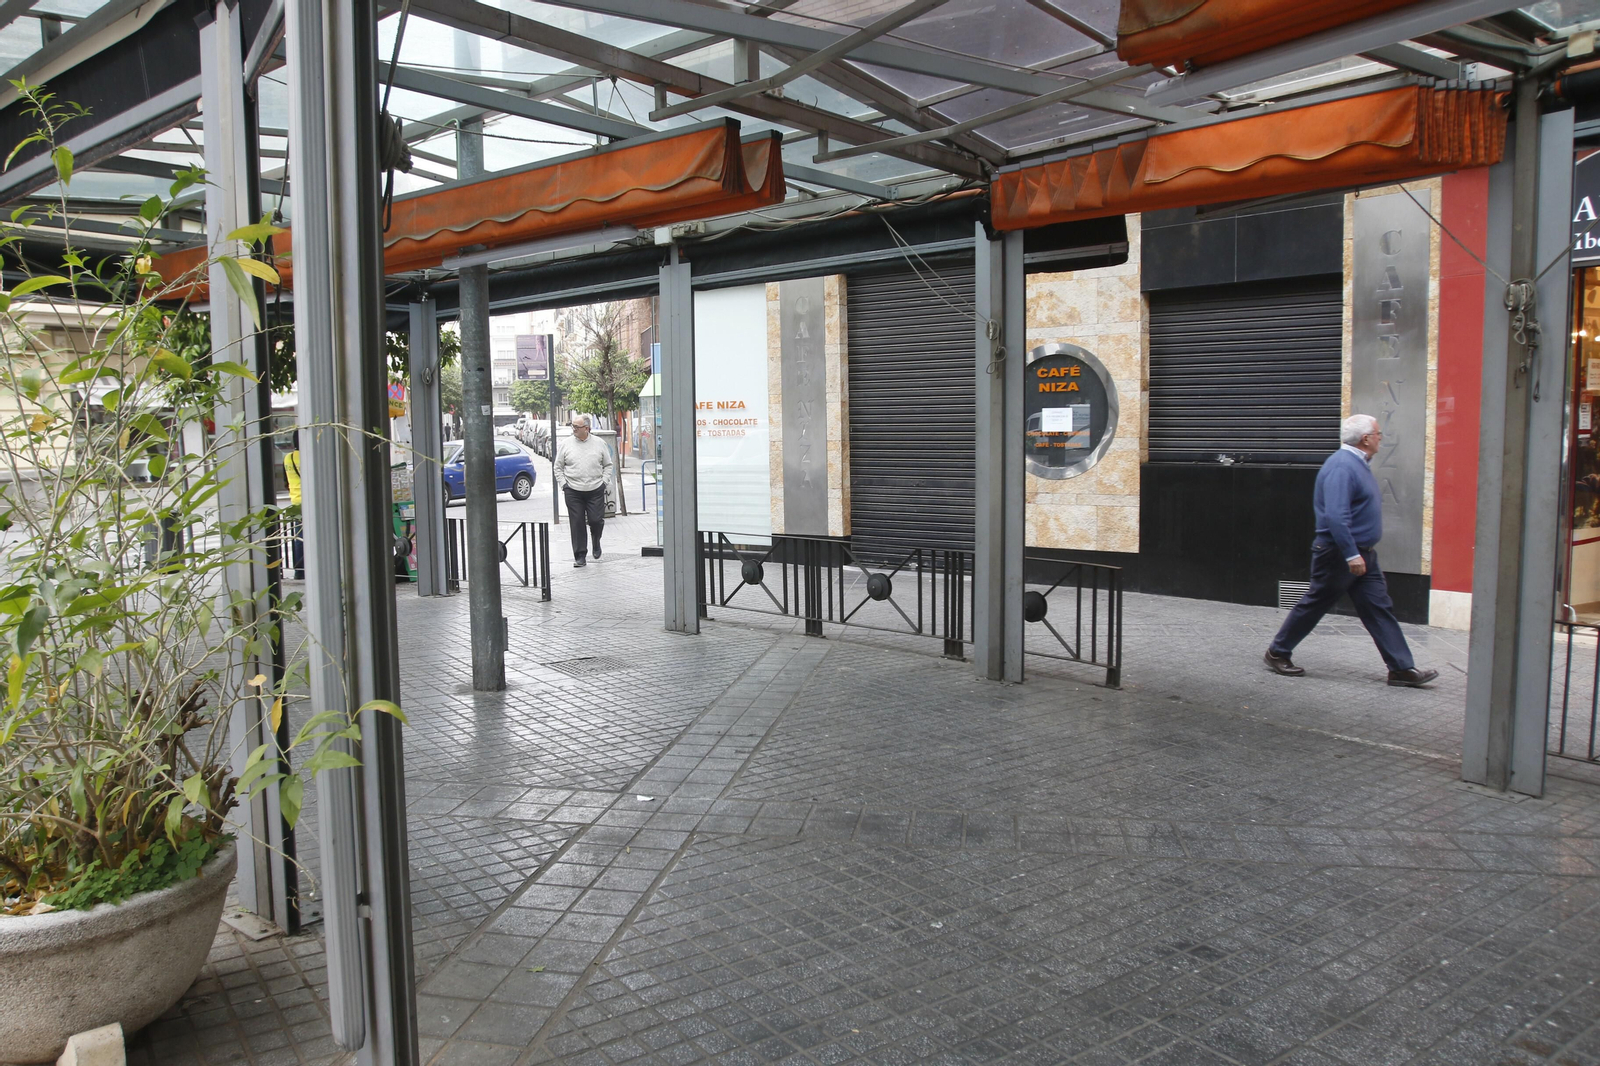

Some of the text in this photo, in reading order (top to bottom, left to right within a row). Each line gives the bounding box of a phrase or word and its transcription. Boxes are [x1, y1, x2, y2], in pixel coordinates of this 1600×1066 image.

[1376, 230, 1404, 360] CAFE
[795, 296, 810, 387] CAFE
[1037, 365, 1080, 378] CAFÉ
[1038, 382, 1079, 392] NIZA
[717, 401, 746, 409] NIZA
[712, 418, 758, 426] CHOCOLATE
[708, 429, 746, 437] TOSTADAS
